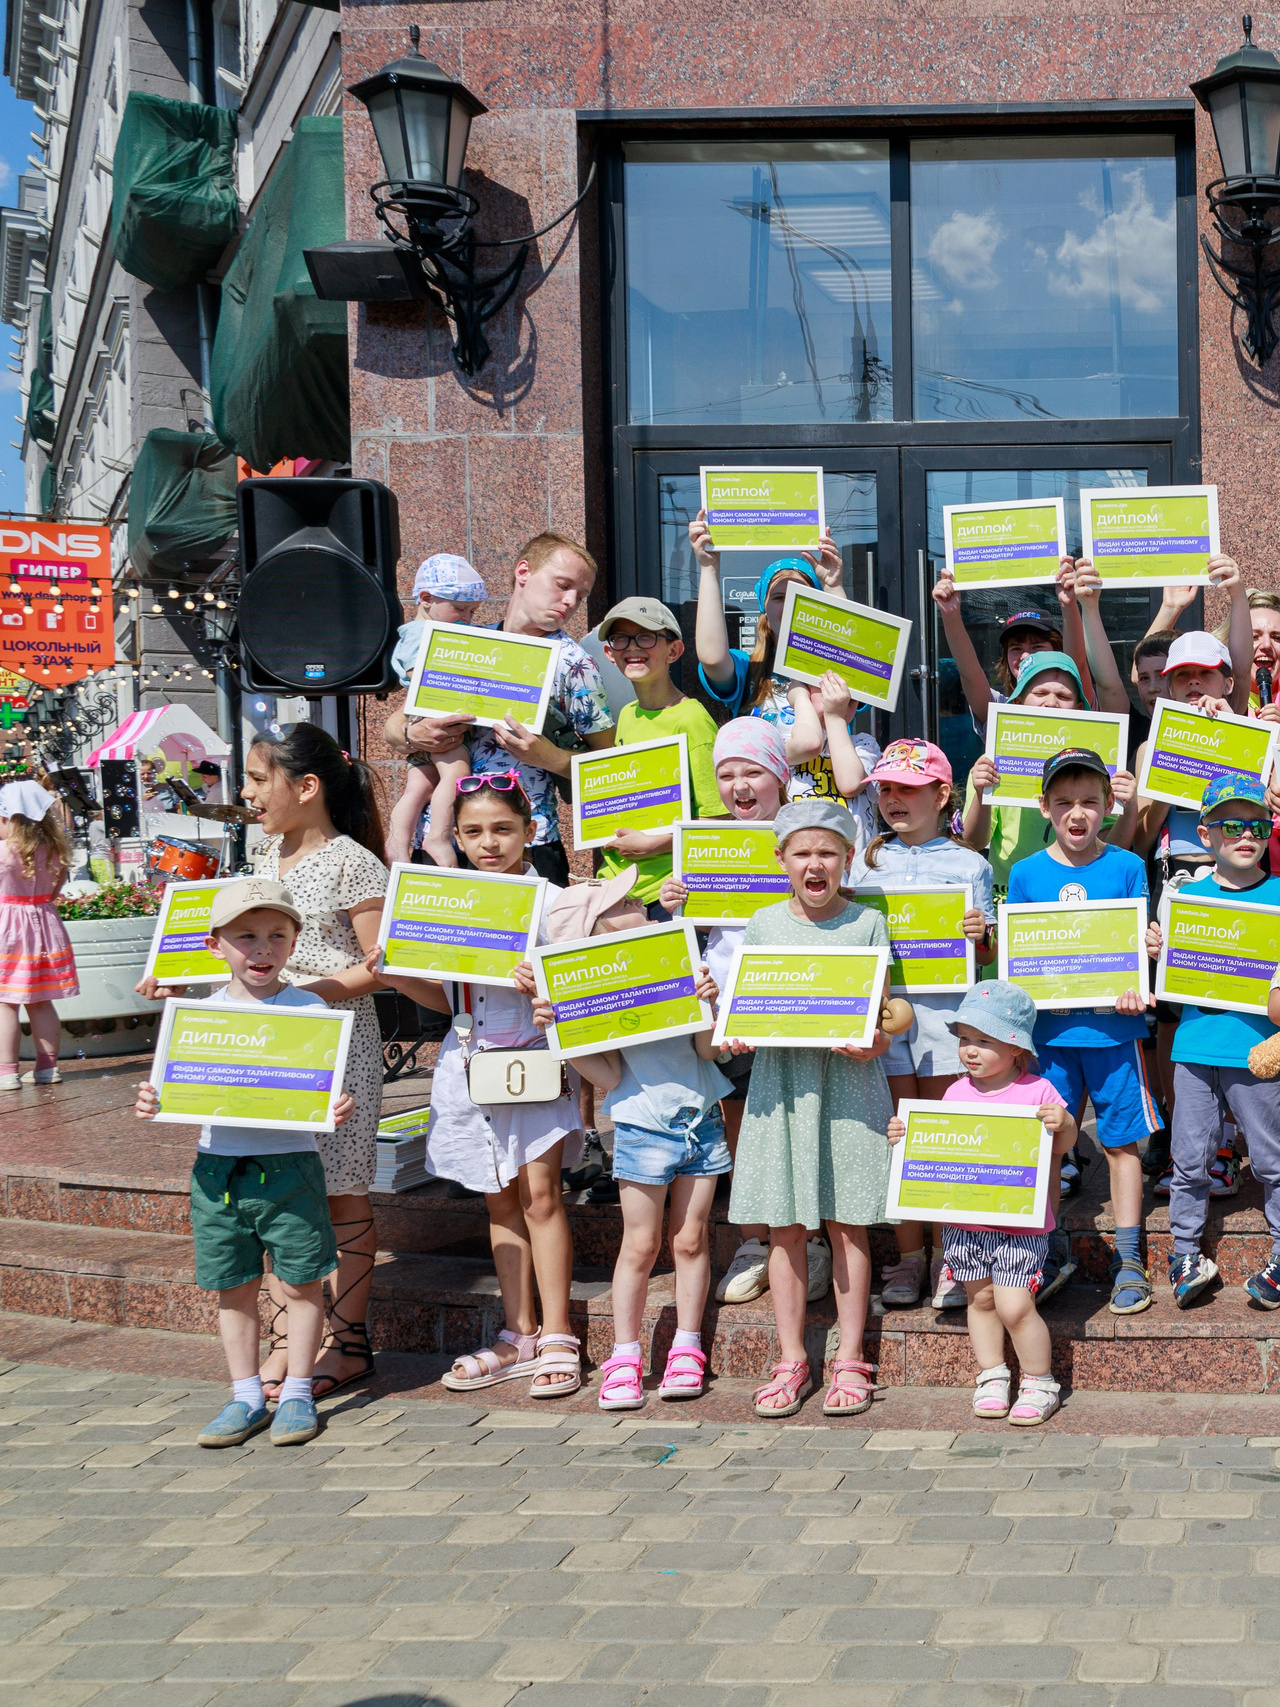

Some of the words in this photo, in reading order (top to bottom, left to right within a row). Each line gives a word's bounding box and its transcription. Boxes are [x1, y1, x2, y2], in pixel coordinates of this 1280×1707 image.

[711, 487, 769, 497] ДИПЛОМ
[1097, 513, 1157, 525] ДИПЛОМ
[957, 523, 1011, 536] ДИПЛОМ
[0, 530, 102, 558] DNS
[18, 564, 82, 578] ГИПЕР
[795, 610, 852, 636] ДИПЛОМ
[3, 640, 101, 654] ЦОКОЛЬНЫЙ
[32, 655, 74, 666] ЭТАЖ
[432, 647, 497, 665] ДИПЛОМ
[1000, 730, 1065, 745] ДИПЛОМ
[1162, 726, 1220, 747] ДИПЛОМ
[584, 769, 636, 789] ДИПЛОМ
[687, 847, 749, 858] ДИПЛОМ
[400, 892, 473, 909] ДИПЛОМ
[170, 906, 211, 920] ДИПЛО
[395, 930, 423, 938] ЮНОМУ
[424, 933, 467, 943] КОНДИТЕРУ
[423, 925, 454, 934] САМОМУ
[455, 929, 513, 941] ТАЛАНТЛИВОМУ
[1012, 928, 1080, 943] ДИПЛОМ
[1174, 921, 1239, 940] ДИПЛОМ
[1069, 956, 1124, 964] ТАЛАНТЛИВОМУ
[1172, 951, 1196, 959] ВЫДАН
[1196, 954, 1225, 964] САМОМУ
[1172, 958, 1197, 967] ЮНОМУ
[1198, 962, 1237, 972] КОНДИТЕРУ
[552, 960, 627, 987] ДИПЛОМ
[741, 971, 815, 982] ДИПЛОМ
[557, 1001, 585, 1011] ВЫДАН
[586, 994, 618, 1006] САМОМУ
[619, 981, 679, 999] ТАЛАНТЛИВОМУ
[559, 1008, 588, 1019] ЮНОМУ
[590, 998, 634, 1012] КОНДИТЕРУ
[178, 1030, 267, 1047] ДИПЛОМ
[206, 1066, 244, 1075] САМОМУ
[245, 1069, 316, 1080] ТАЛАНТЛИВОМУ
[207, 1075, 259, 1084] КОНДИТЕРУ
[911, 1131, 981, 1145] ДИПЛОМ
[908, 1163, 933, 1171] ВЫДАН
[966, 1167, 1024, 1176] ТАЛАНТЛИВОМУ
[936, 1173, 978, 1181] КОНДИТЕРУ
